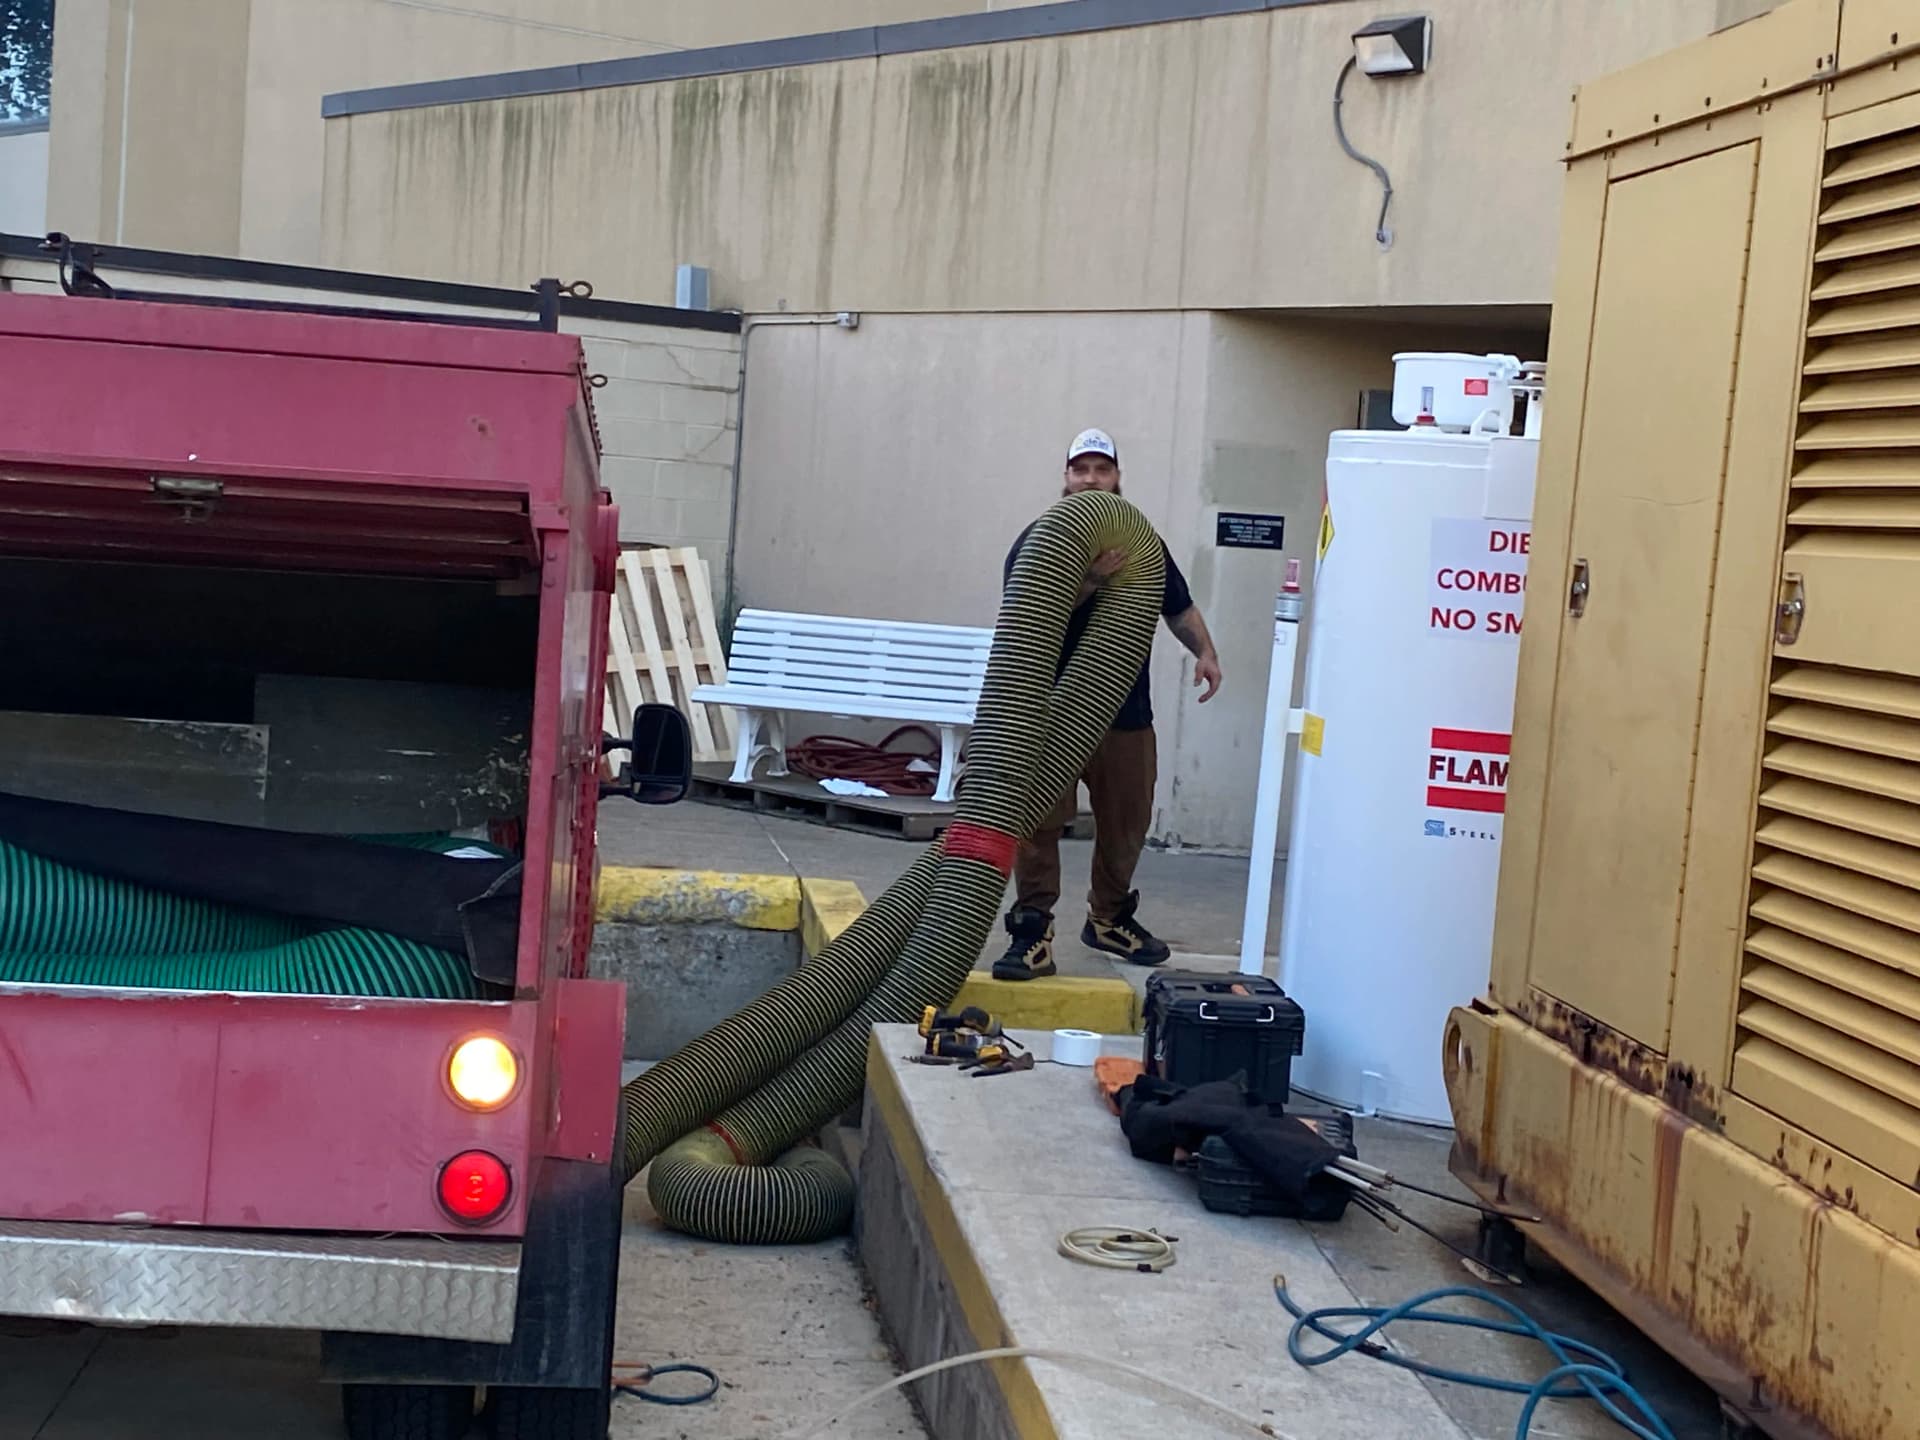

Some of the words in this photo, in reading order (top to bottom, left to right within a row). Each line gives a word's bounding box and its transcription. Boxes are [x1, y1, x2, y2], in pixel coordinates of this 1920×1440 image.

[1489, 530, 1531, 554] DIE
[1437, 568, 1527, 594] COMB
[1431, 606, 1476, 630] NO
[1429, 755, 1509, 787] FLAM
[1449, 827, 1496, 840] STEEL
